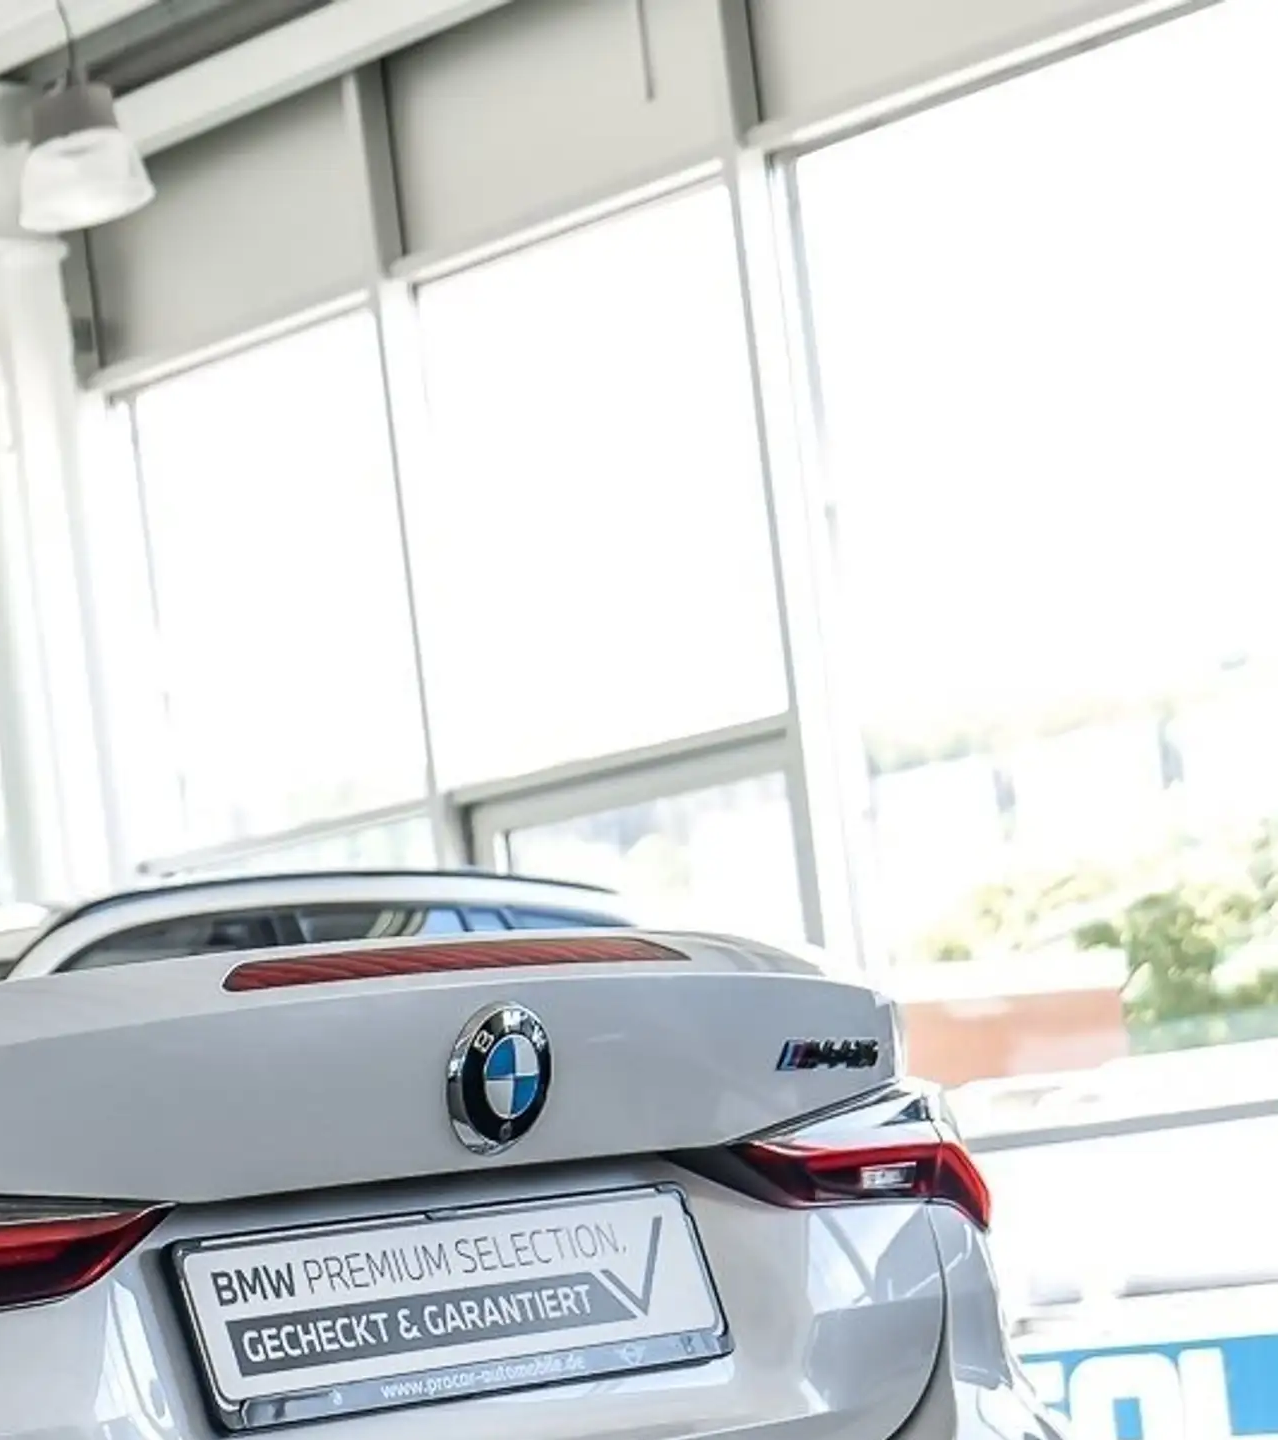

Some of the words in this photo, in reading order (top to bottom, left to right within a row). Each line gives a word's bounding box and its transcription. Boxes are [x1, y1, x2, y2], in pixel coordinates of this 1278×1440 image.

[473, 1009, 548, 1053] BMW
[210, 1261, 297, 1307] BMW
[302, 1241, 453, 1295] PREMIUM
[453, 1221, 629, 1276] SELECTION.
[242, 1311, 391, 1364] GECHECKT
[397, 1311, 423, 1339] &
[423, 1282, 593, 1338] GARANTIERT
[379, 1353, 587, 1400] www.procar-automobile.de
